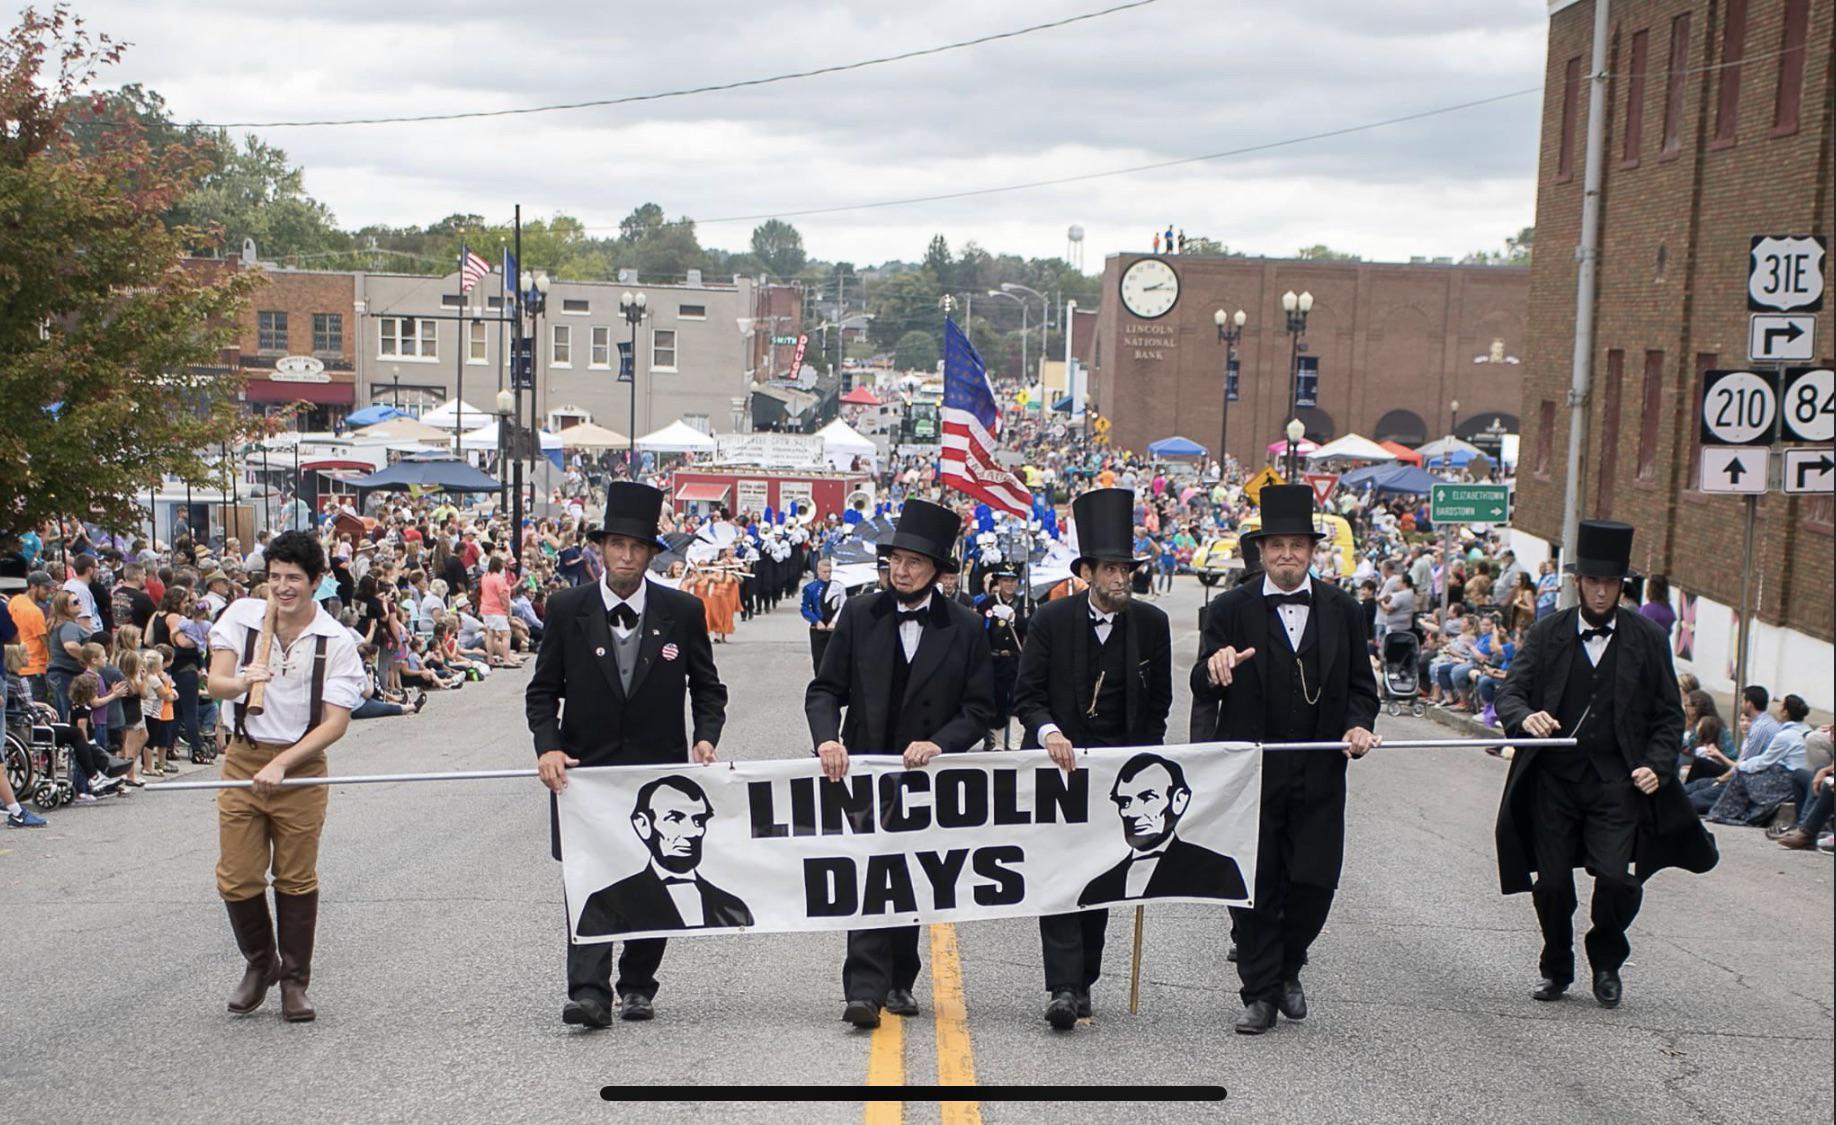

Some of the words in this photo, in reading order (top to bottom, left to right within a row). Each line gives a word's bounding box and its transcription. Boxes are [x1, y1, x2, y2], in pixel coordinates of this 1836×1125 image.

[1764, 254, 1809, 294] 31E
[1125, 324, 1174, 335] LINCOLN
[770, 335, 798, 345] SMITH
[1124, 337, 1176, 348] NATIONAL
[789, 334, 808, 379] DRUGS
[1134, 350, 1163, 360] BANK
[1715, 387, 1766, 429] 210
[1452, 490, 1505, 501] ELIZABETHTOWN
[1436, 506, 1475, 516] BARDSTOWN
[748, 768, 1089, 838] LINCOLN
[803, 845, 1025, 917] DAYS
